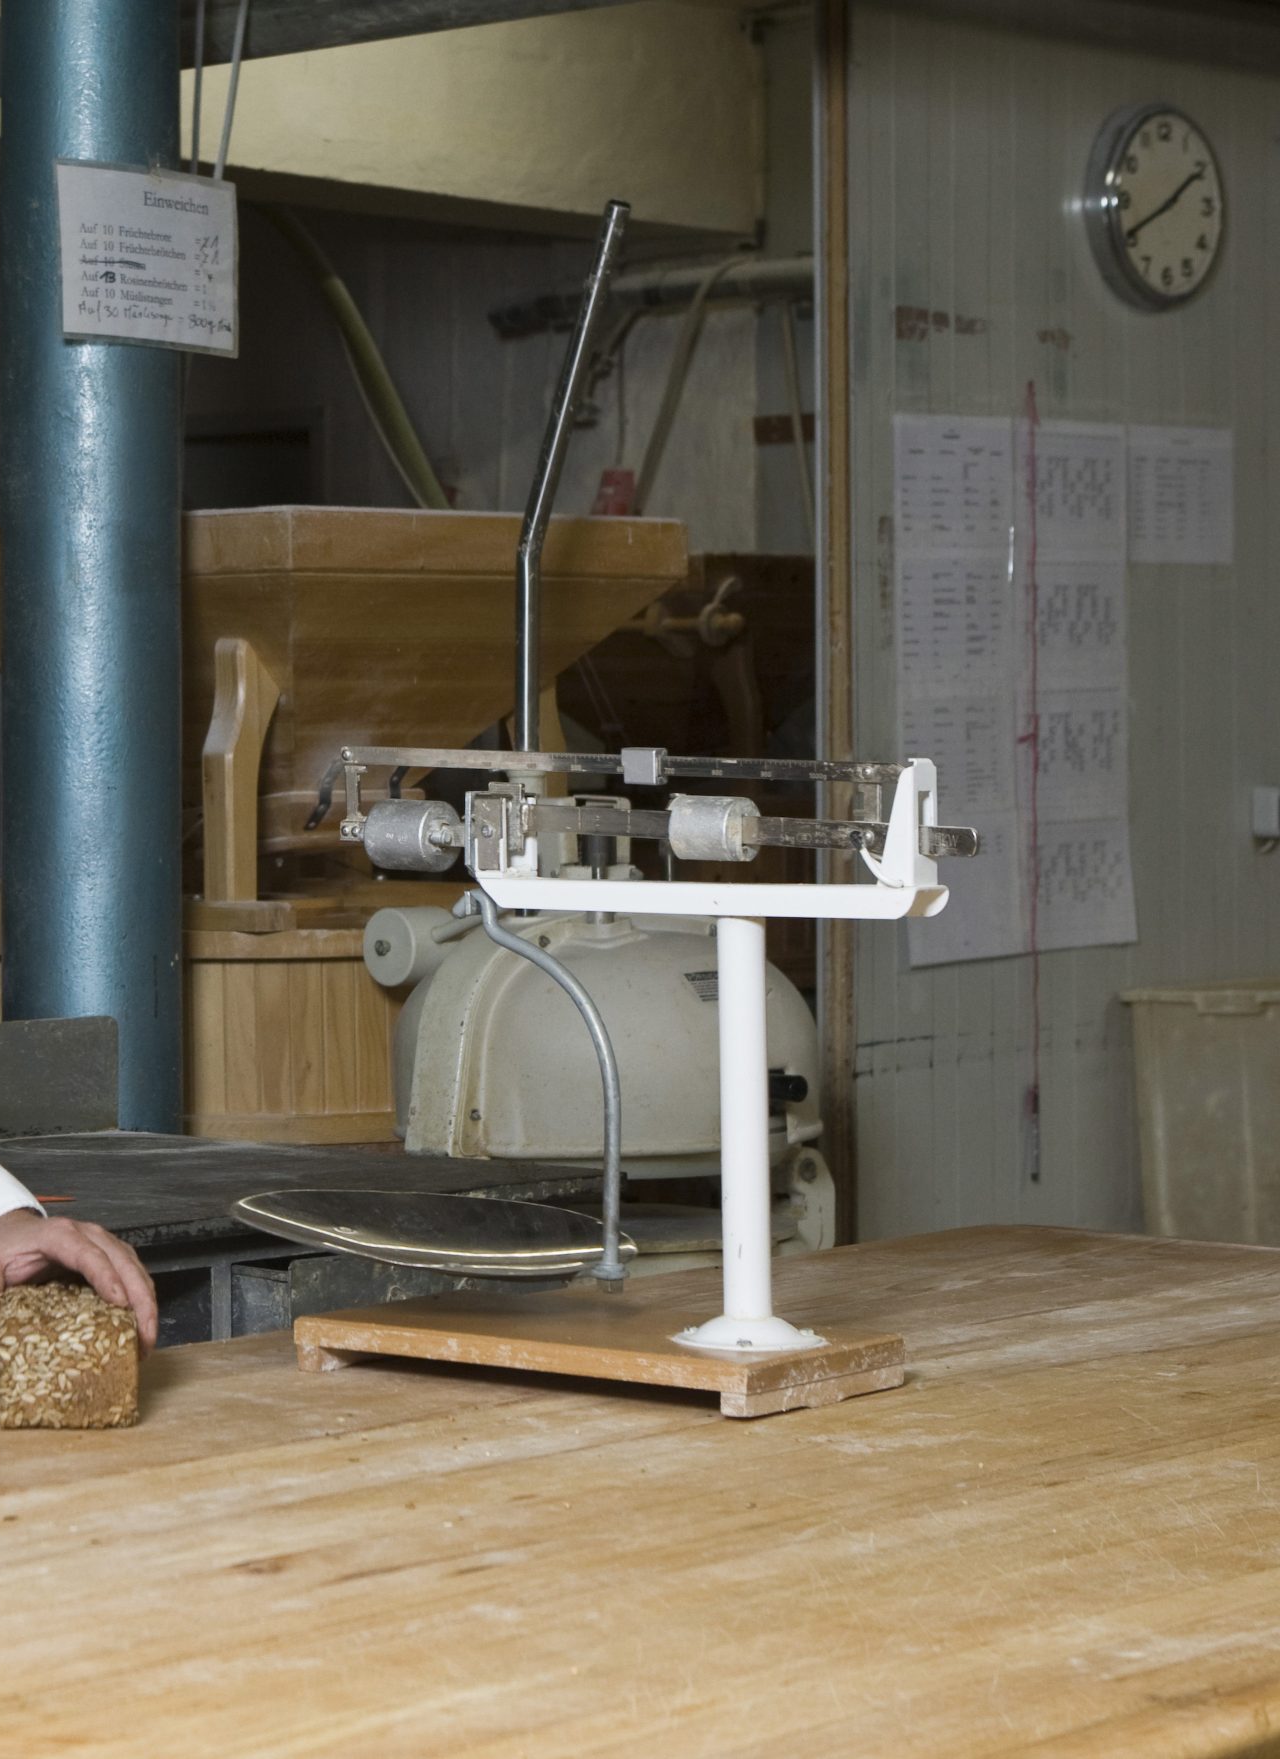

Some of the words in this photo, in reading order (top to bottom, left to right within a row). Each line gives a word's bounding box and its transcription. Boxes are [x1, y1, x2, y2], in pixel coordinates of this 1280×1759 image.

[143, 191, 209, 216] Einweichen
[1201, 197, 1214, 217] 3
[81, 223, 98, 234] Auf
[103, 225, 114, 236] 10
[81, 239, 98, 250] Auf
[103, 241, 115, 252] 10
[1196, 234, 1207, 250] 4
[1141, 256, 1151, 274] 7
[1181, 258, 1193, 277] 5
[81, 271, 99, 282] Auf
[1161, 266, 1173, 286] 6
[81, 286, 100, 300] Auf
[105, 288, 116, 300] 10
[78, 300, 101, 322] Auf
